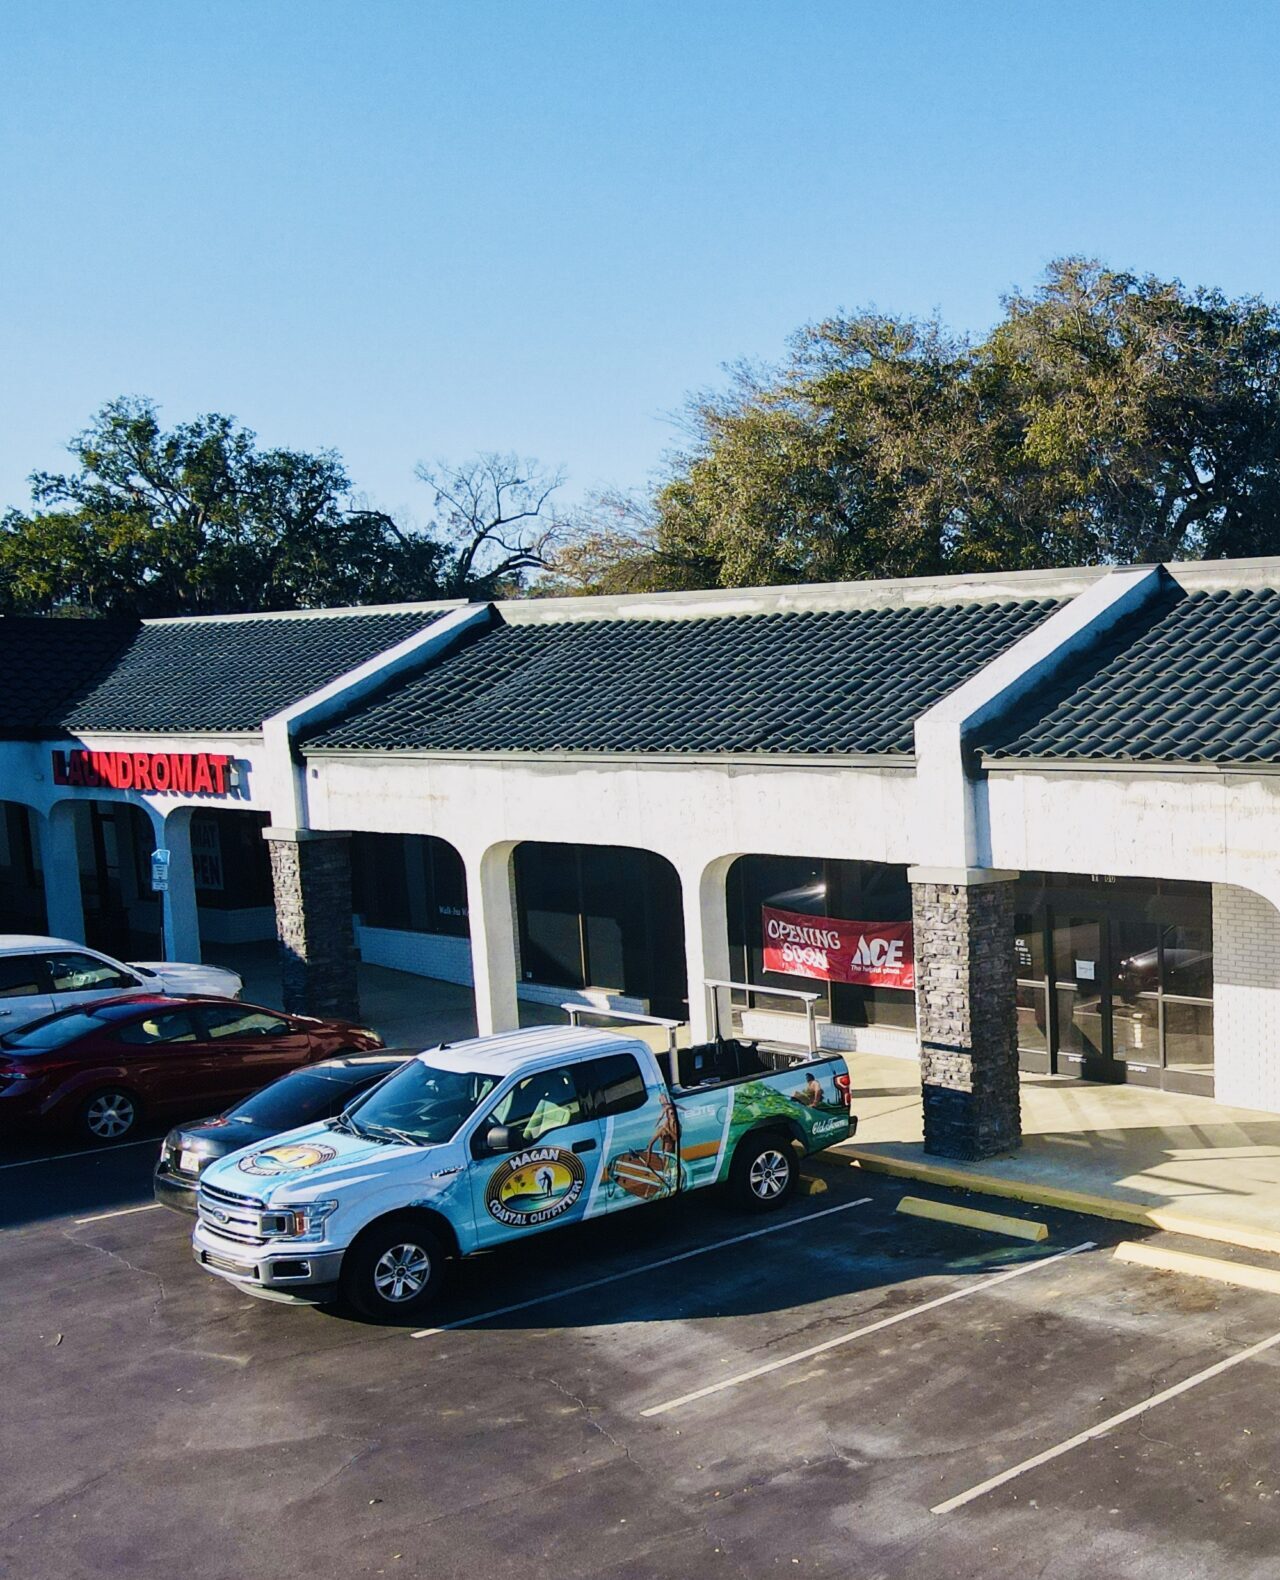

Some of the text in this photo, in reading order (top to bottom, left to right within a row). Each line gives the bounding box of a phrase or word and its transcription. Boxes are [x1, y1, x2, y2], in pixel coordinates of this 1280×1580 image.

[52, 750, 230, 793] LAUNDROMAT
[767, 919, 841, 949] OPENING
[782, 942, 830, 971] SOON
[851, 934, 904, 967] ACE
[851, 964, 862, 972] The
[509, 1148, 560, 1170] HAGAN
[489, 1200, 527, 1225] COASTAL
